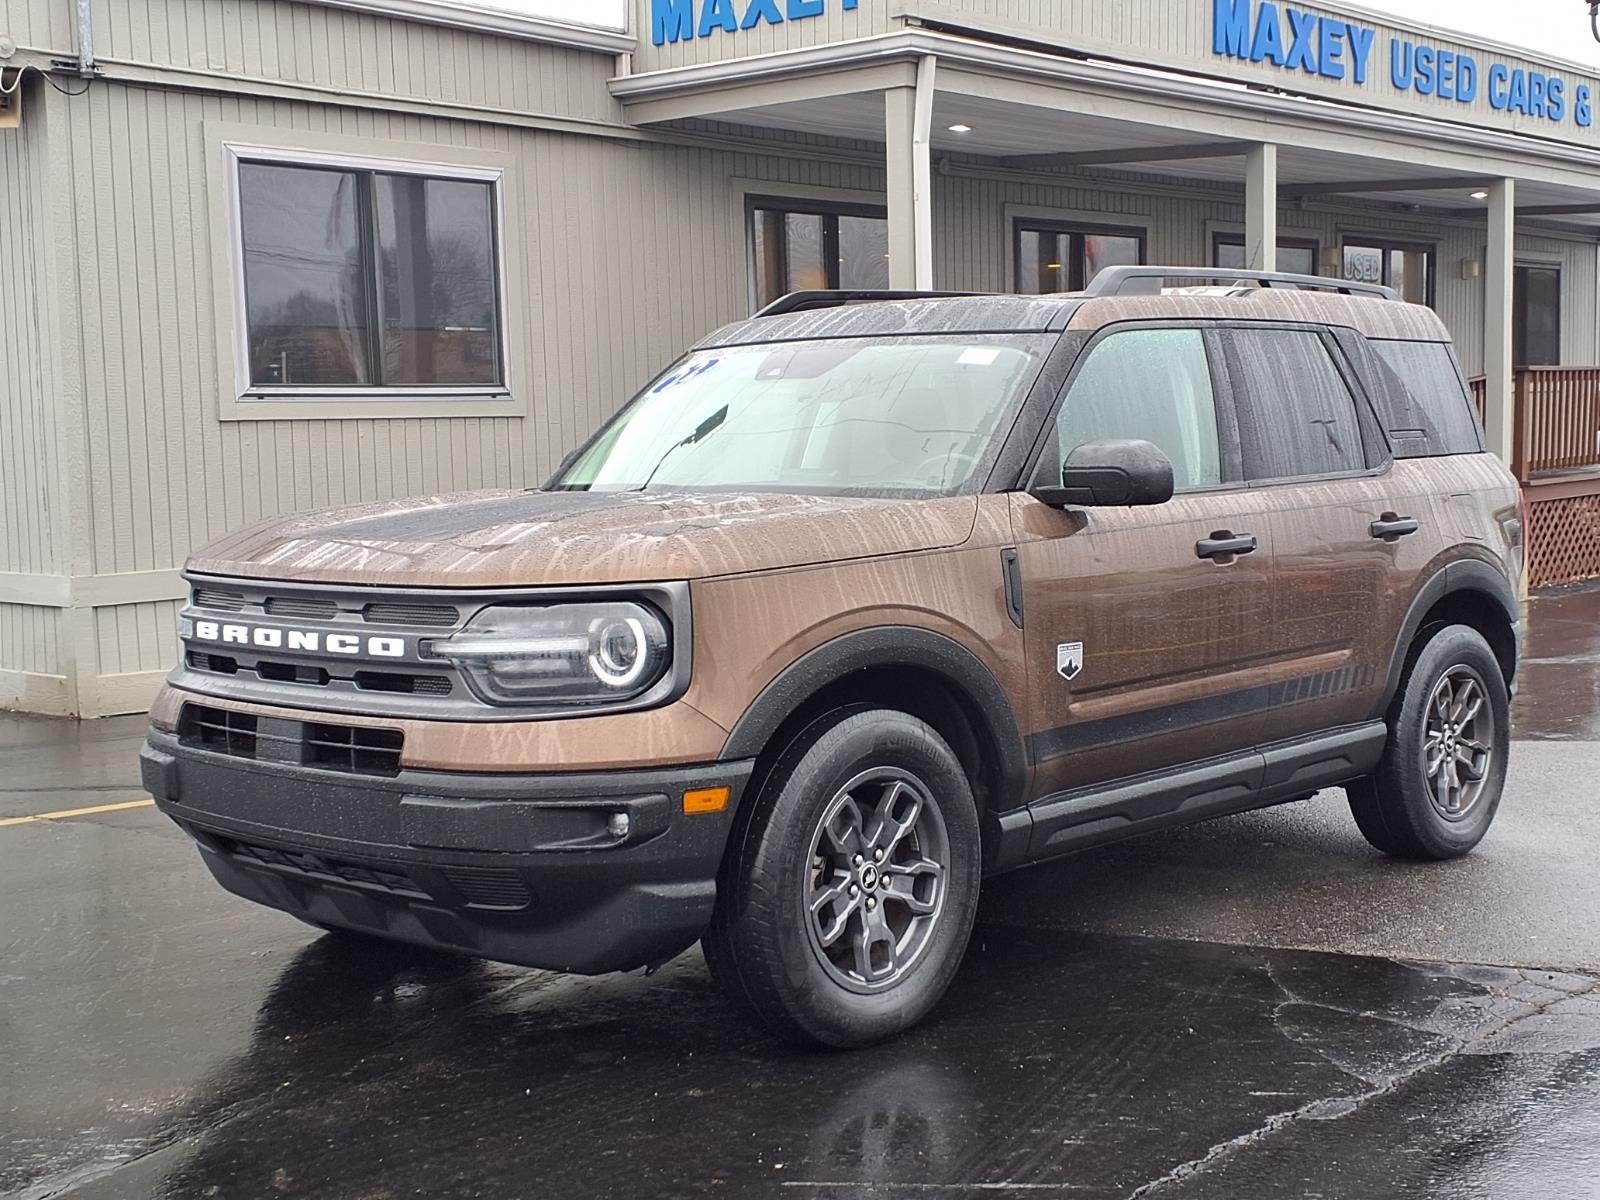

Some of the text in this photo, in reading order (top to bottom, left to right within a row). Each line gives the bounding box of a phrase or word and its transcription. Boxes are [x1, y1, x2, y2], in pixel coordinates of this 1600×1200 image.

[1213, 0, 1591, 127] MAXEY USED CARS &
[1344, 253, 1379, 282] USED
[196, 620, 405, 657] BRONCO
